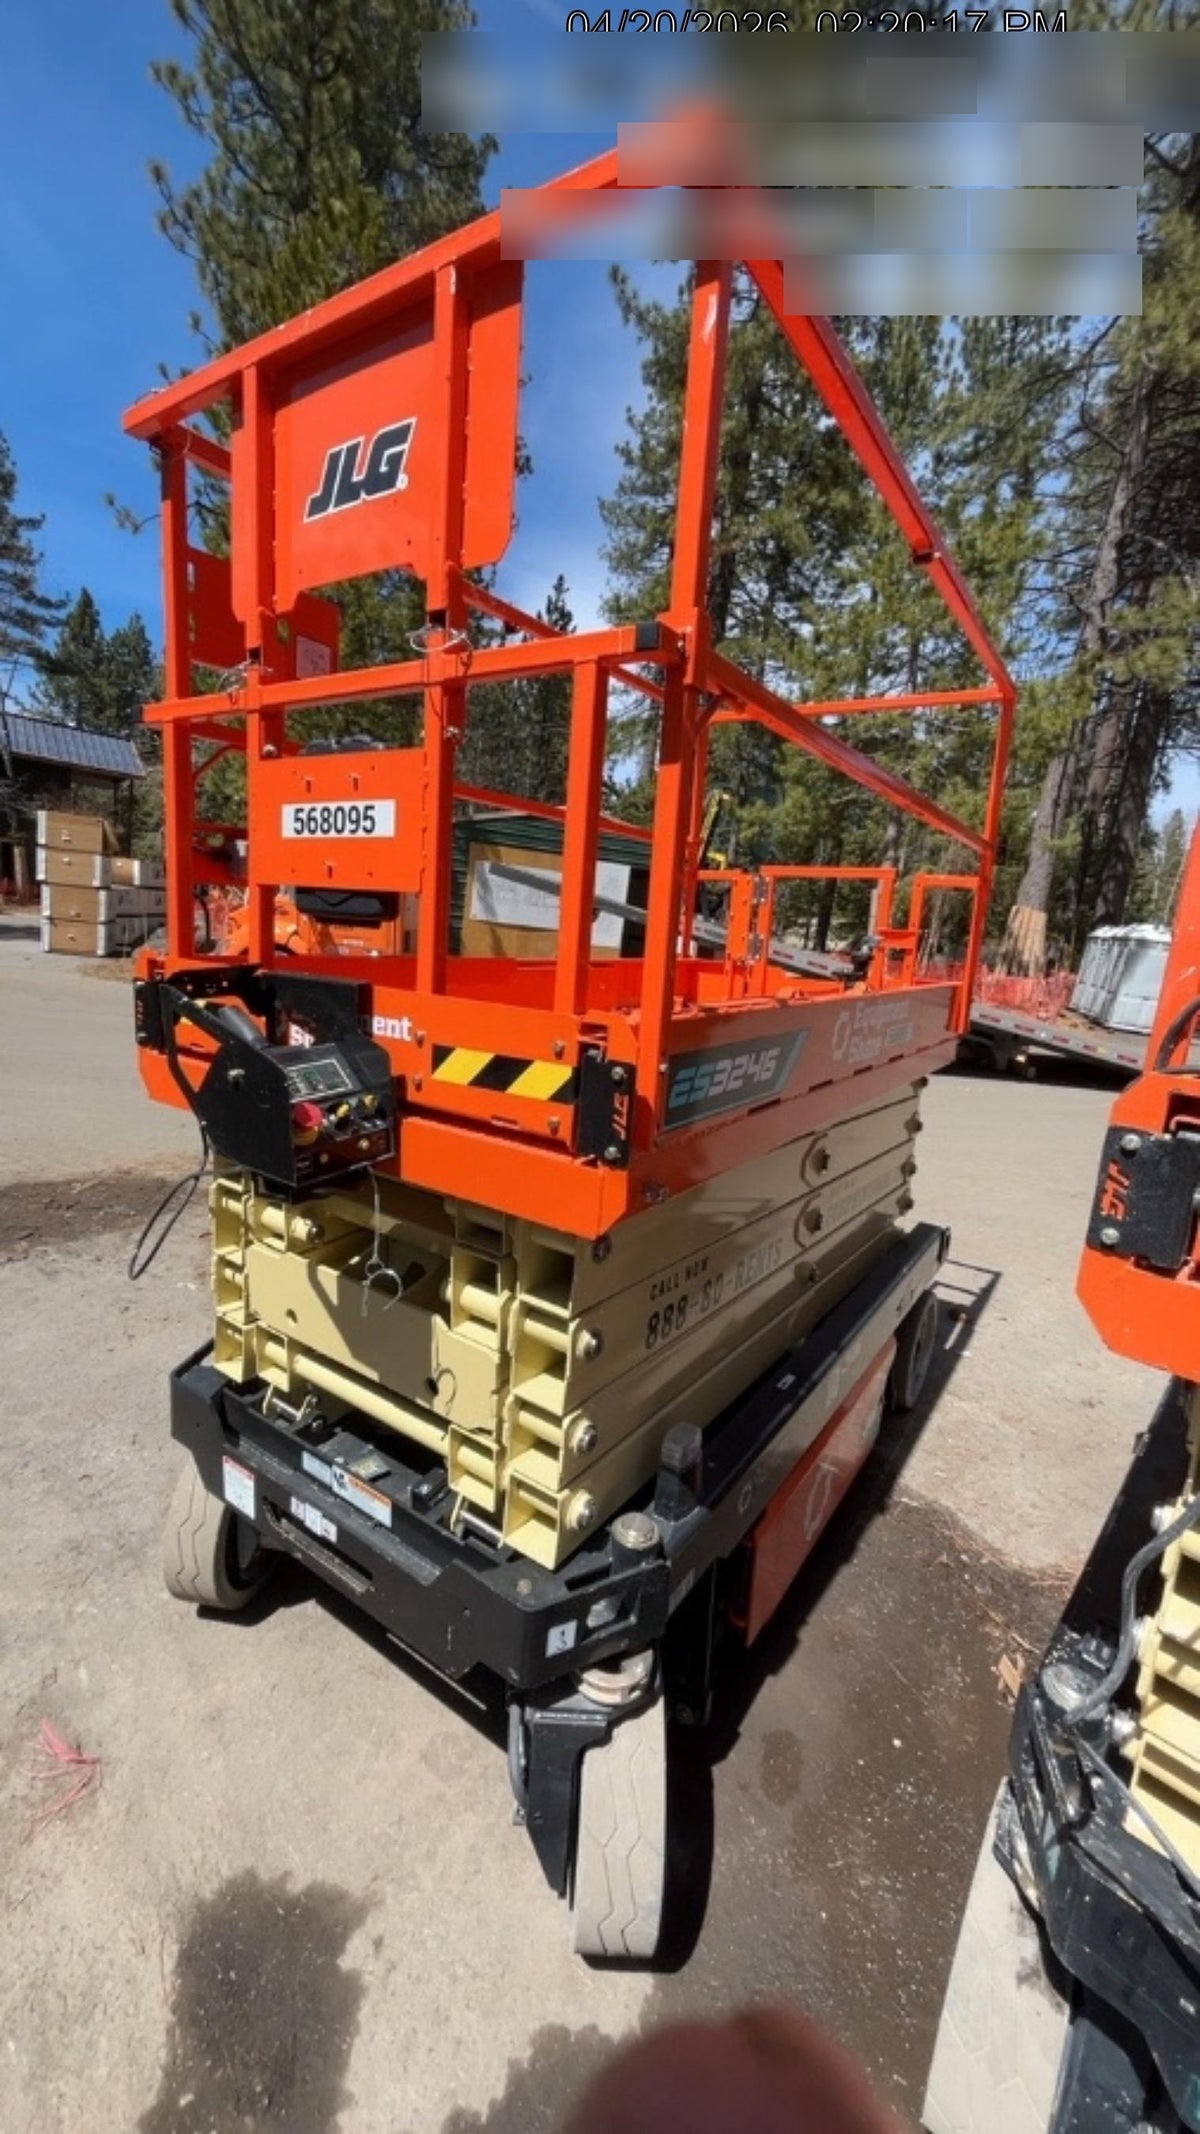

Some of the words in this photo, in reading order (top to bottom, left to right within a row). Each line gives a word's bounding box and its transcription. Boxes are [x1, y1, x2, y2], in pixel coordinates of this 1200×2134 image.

[304, 417, 416, 523] JLG
[293, 805, 375, 835] 568095
[668, 1048, 782, 1108] ES3246
[1101, 1161, 1130, 1220] JLG
[650, 1273, 680, 1301] CALL
